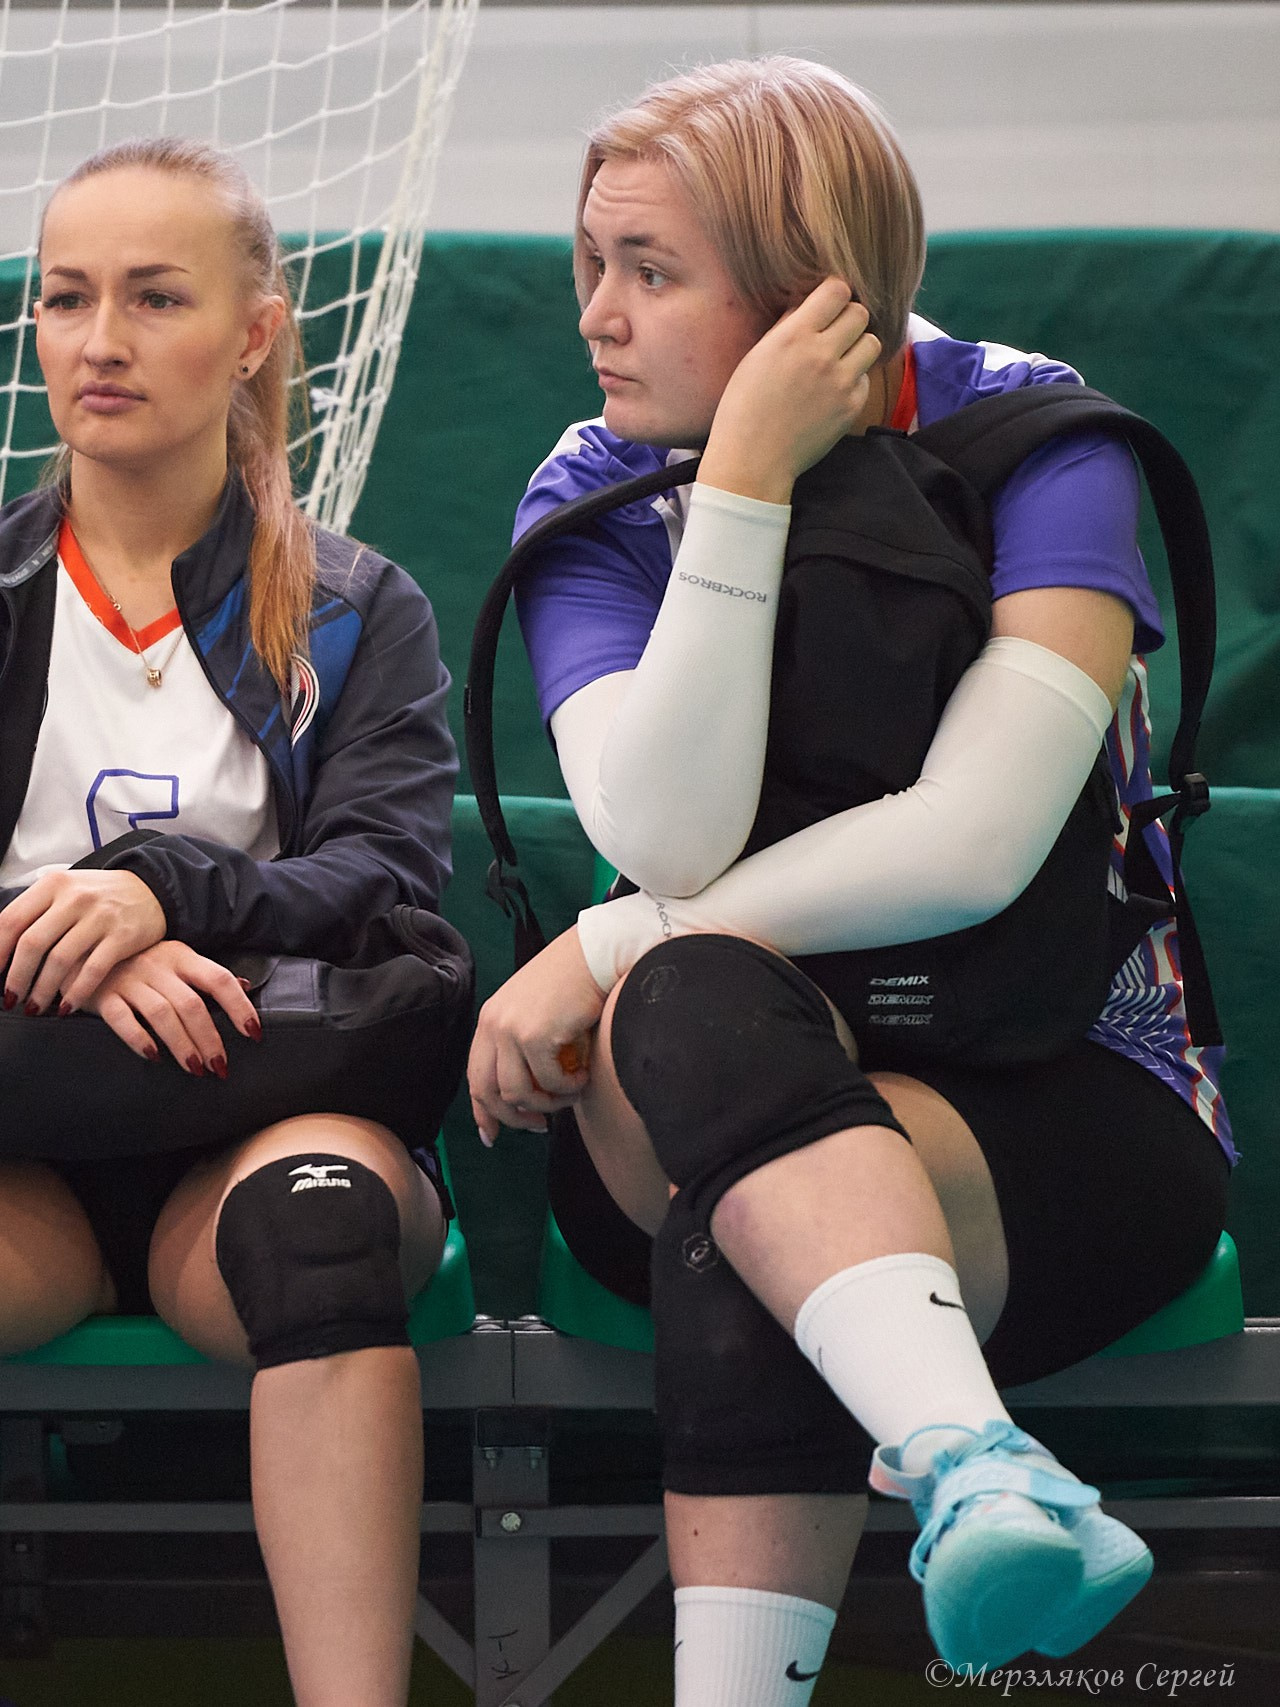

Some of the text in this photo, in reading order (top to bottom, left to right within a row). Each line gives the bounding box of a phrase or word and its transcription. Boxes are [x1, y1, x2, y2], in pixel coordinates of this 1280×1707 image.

[678, 571, 768, 603] ROCKBROS
[870, 975, 929, 987] DEMIX
[868, 993, 934, 1005] DEMIX
